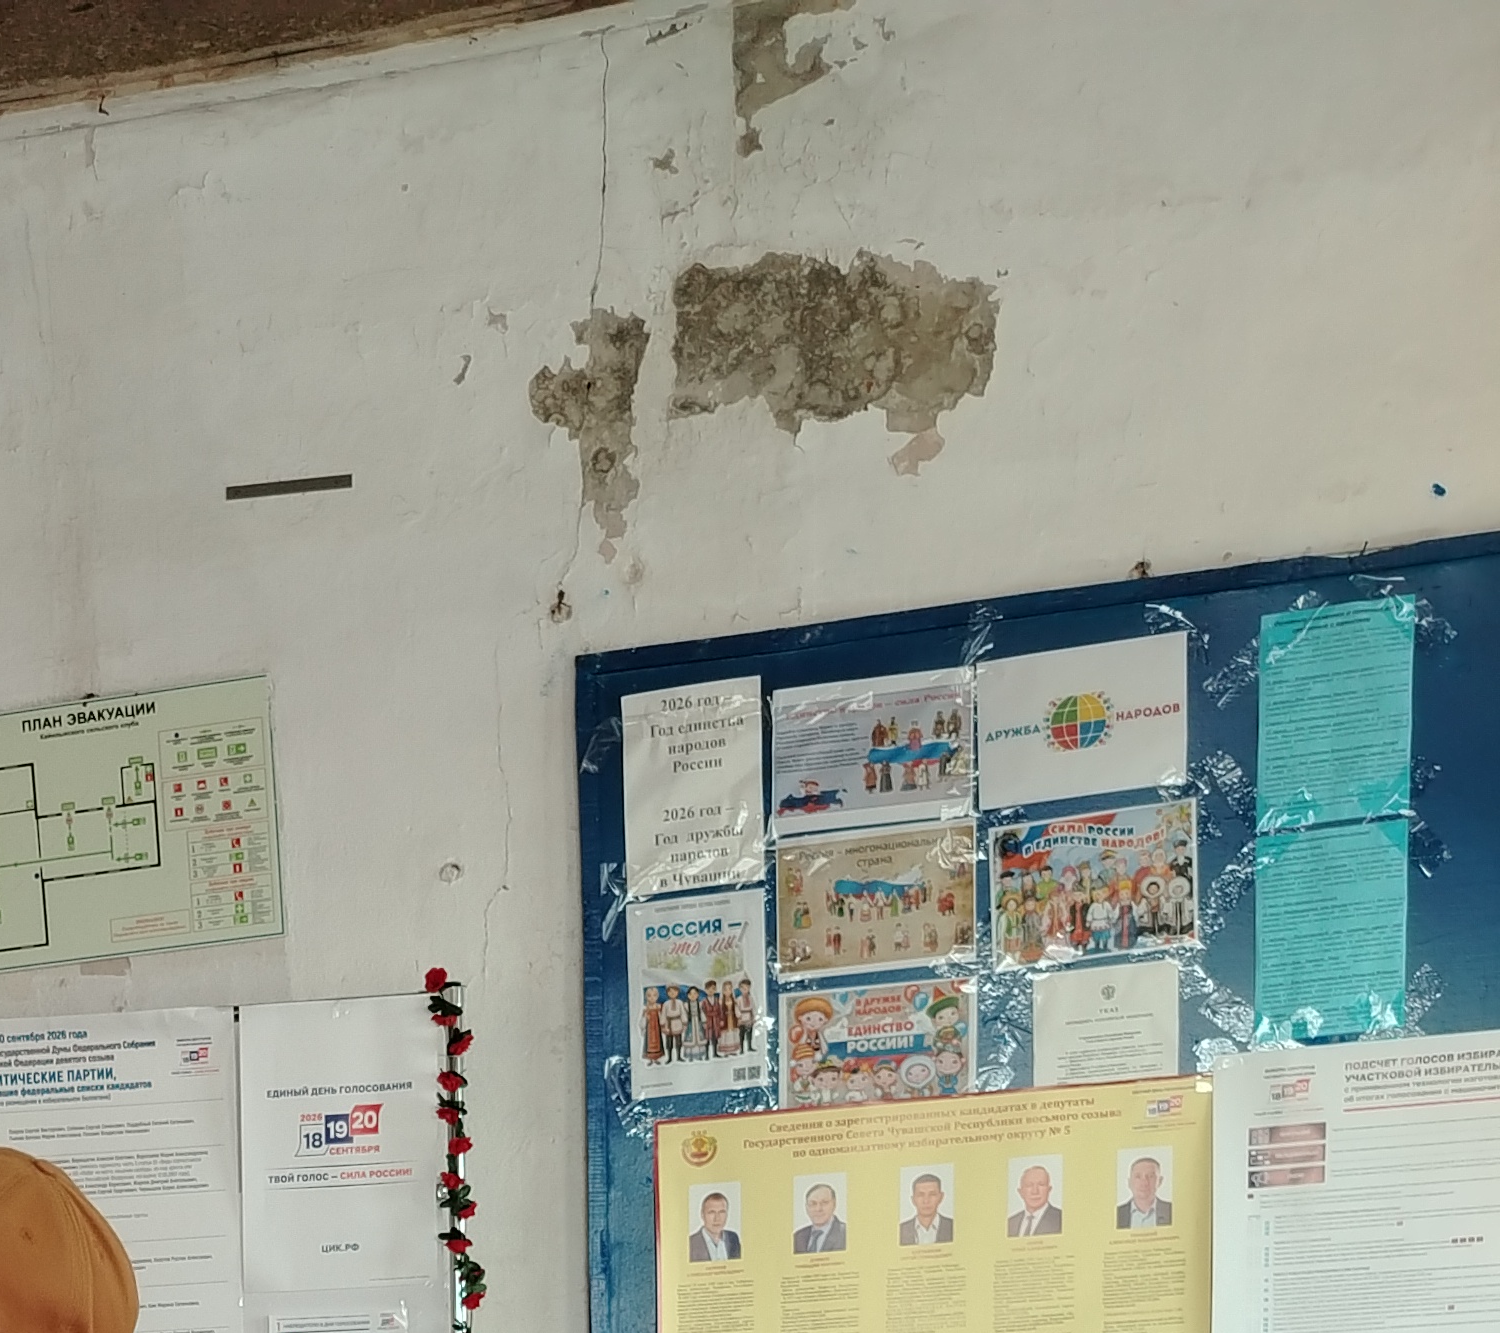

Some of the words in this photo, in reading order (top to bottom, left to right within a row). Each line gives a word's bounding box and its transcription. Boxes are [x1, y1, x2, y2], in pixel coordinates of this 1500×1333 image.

[661, 698, 693, 711] 2026
[1116, 703, 1180, 721] НАРОДОВ
[22, 716, 62, 733] ПЛАН
[67, 702, 155, 726] ЭВАКУАЦИИ
[650, 724, 674, 738] Год
[678, 717, 744, 734] единства
[985, 725, 1040, 743] ДРУЖБА
[668, 738, 726, 756] народов
[673, 757, 723, 773] России
[663, 807, 695, 822] 2026
[700, 806, 721, 817] год
[655, 834, 677, 846] Год
[686, 825, 743, 844] дружбы
[671, 847, 729, 865] народов
[857, 856, 892, 868] страна
[646, 919, 722, 941] РОССИЯ
[7, 1033, 45, 1043] сентября
[47, 1030, 66, 1040] 2026
[69, 1031, 87, 1040] года
[848, 1022, 914, 1037] ЕДИНСТВО
[123, 1040, 155, 1049] Собрания
[847, 1036, 914, 1053] РОССИИ!
[89, 1054, 114, 1062] созыва
[1345, 1057, 1398, 1071] ПОДСЧЕТ
[1400, 1055, 1455, 1066] ГОЛОСОВ
[67, 1068, 117, 1082] ПАРТИИ,
[1344, 1068, 1421, 1083] УЧАСТКОВОЙ
[77, 1084, 104, 1093] списки
[107, 1081, 152, 1090] кандидатов
[267, 1086, 309, 1099] ЕДИНЫЙ
[311, 1087, 337, 1096] ДЕНЬ
[339, 1081, 412, 1094] ГОЛОСОВАНИЯ
[300, 1113, 323, 1122] 2026
[303, 1132, 323, 1149] 18
[326, 1121, 348, 1139] 19
[352, 1112, 377, 1129] 20
[769, 1121, 824, 1133] Сведения
[329, 1145, 380, 1155] СЕНТЯБРЯ
[268, 1173, 295, 1184] ТВОЙ
[297, 1172, 329, 1182] ГОЛОС
[340, 1170, 366, 1180] СИЛА
[369, 1168, 412, 1178] РОССИИ!
[321, 1243, 359, 1253] ЦИК.РФ
